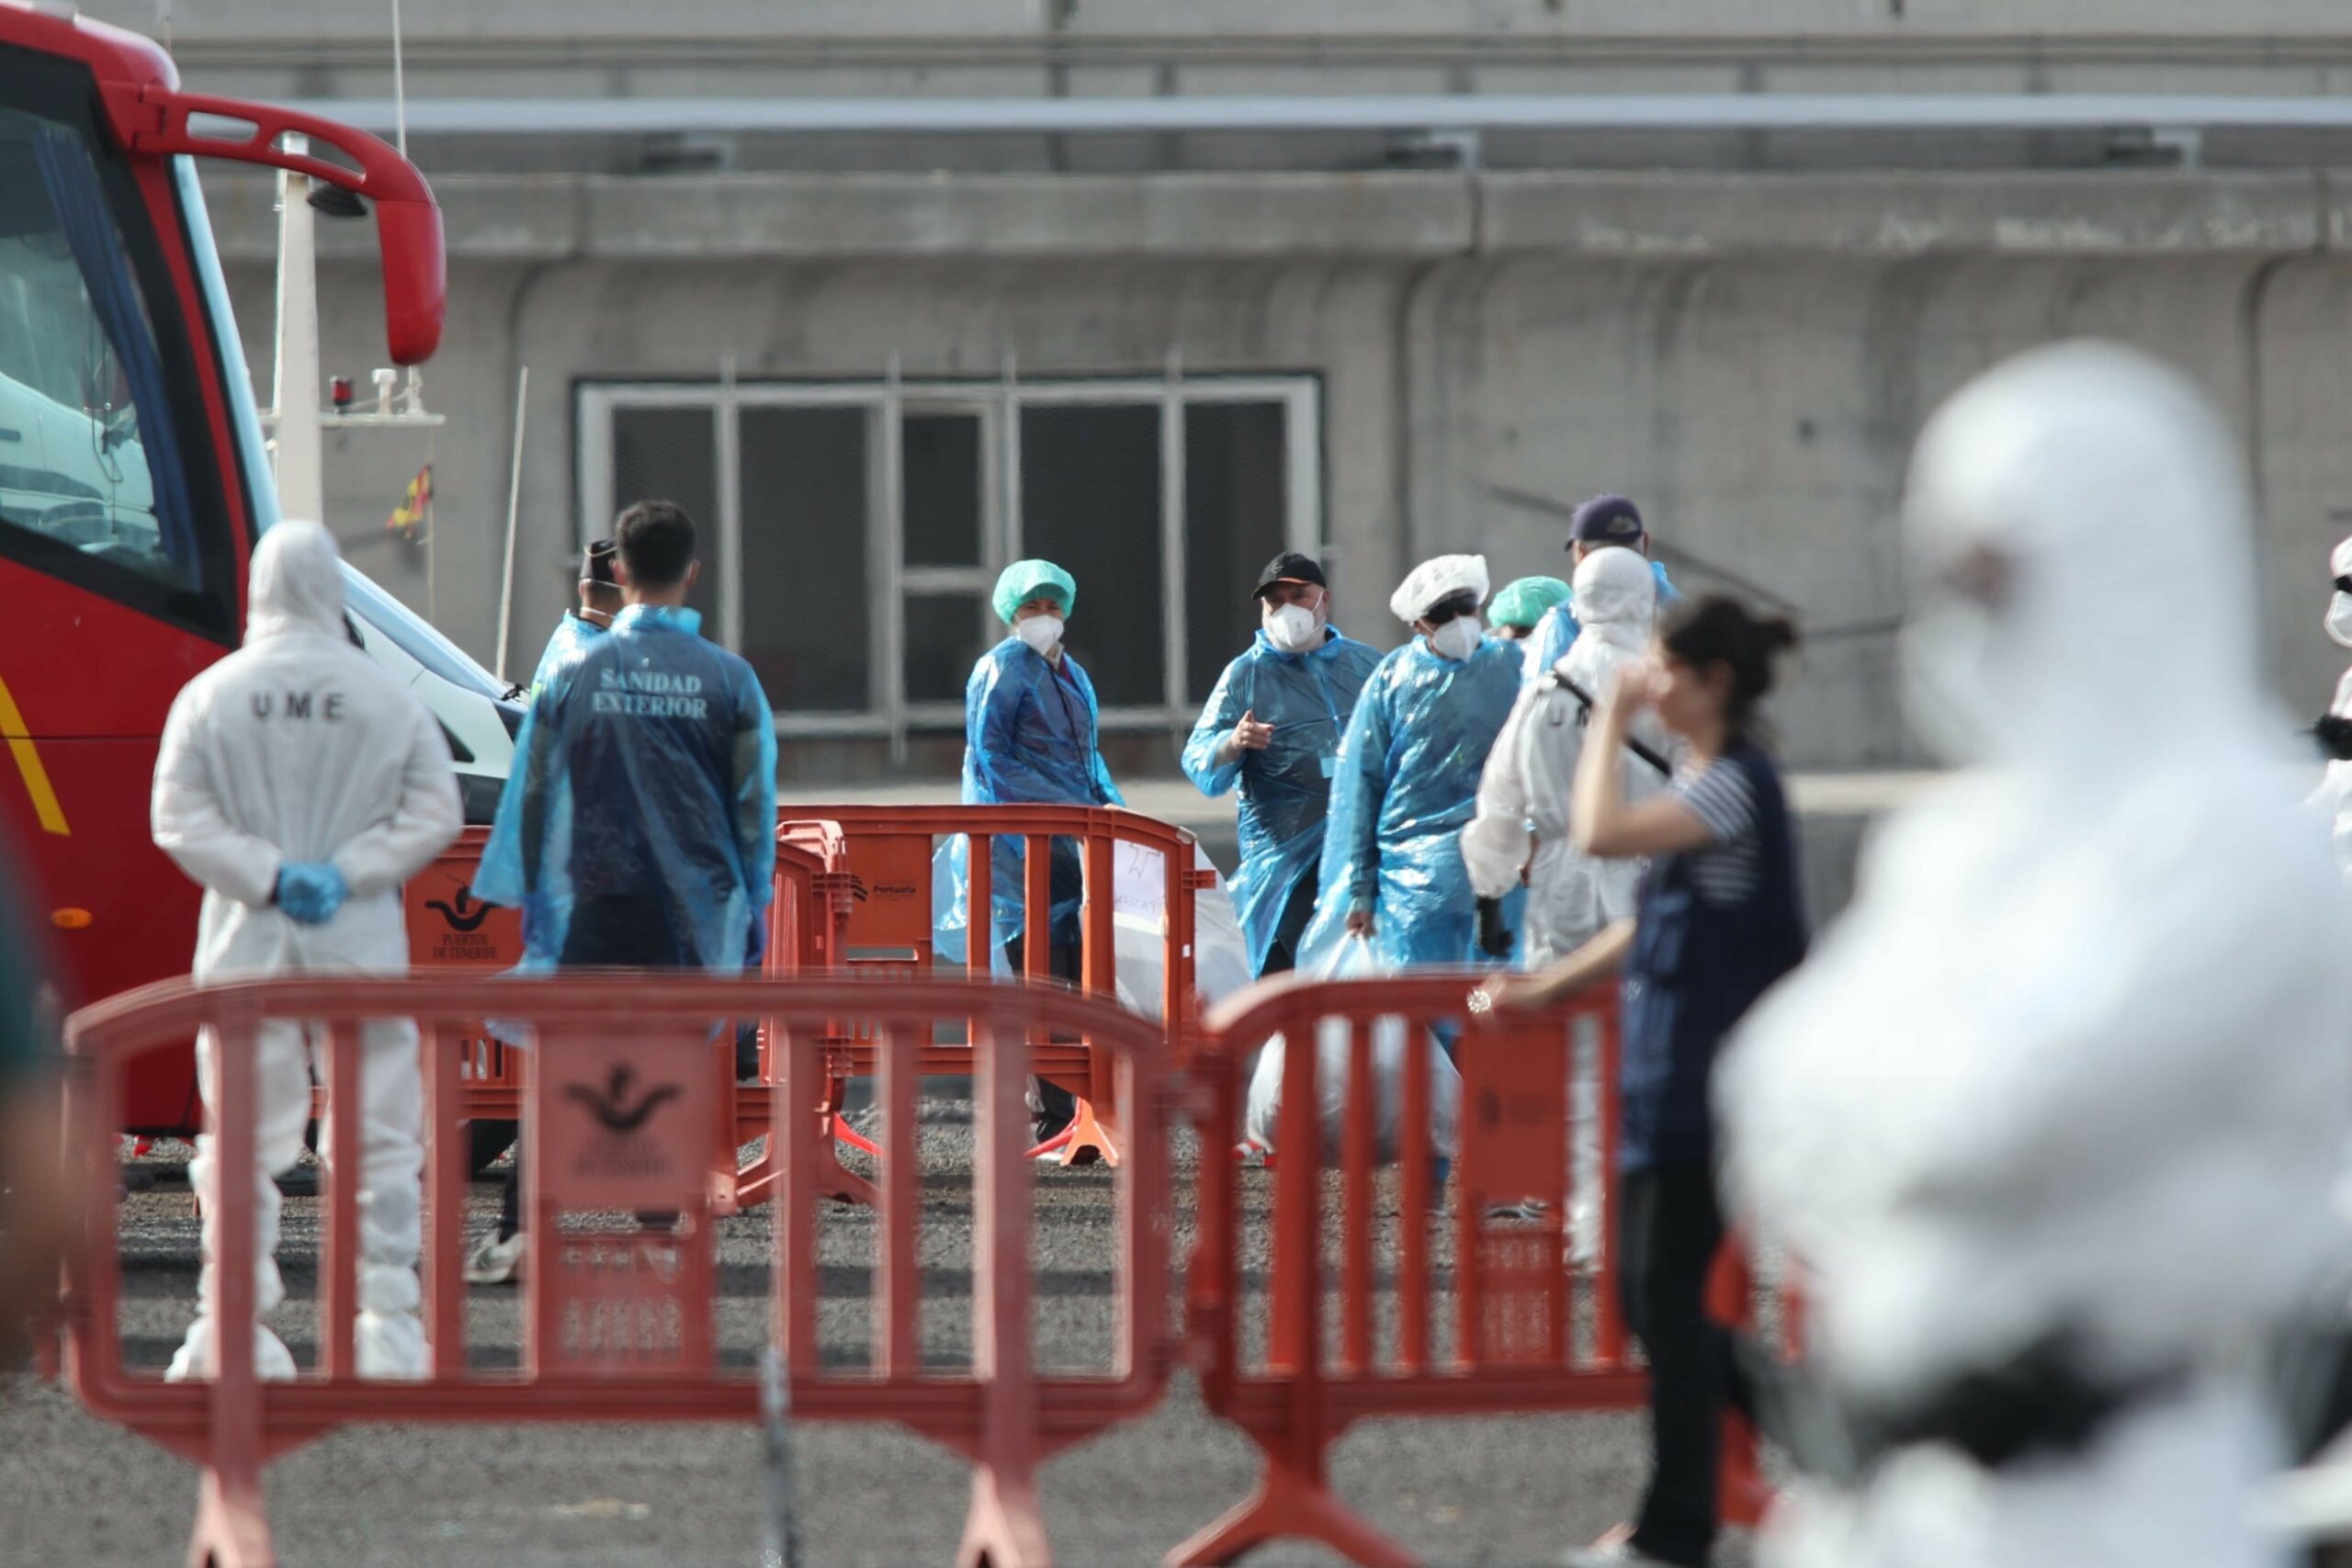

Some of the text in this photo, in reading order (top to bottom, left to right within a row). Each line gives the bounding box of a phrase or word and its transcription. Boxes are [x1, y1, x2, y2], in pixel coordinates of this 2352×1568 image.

[600, 668, 703, 694] SANIDAD
[250, 690, 345, 720] UME
[592, 691, 707, 719] EXTERIOR
